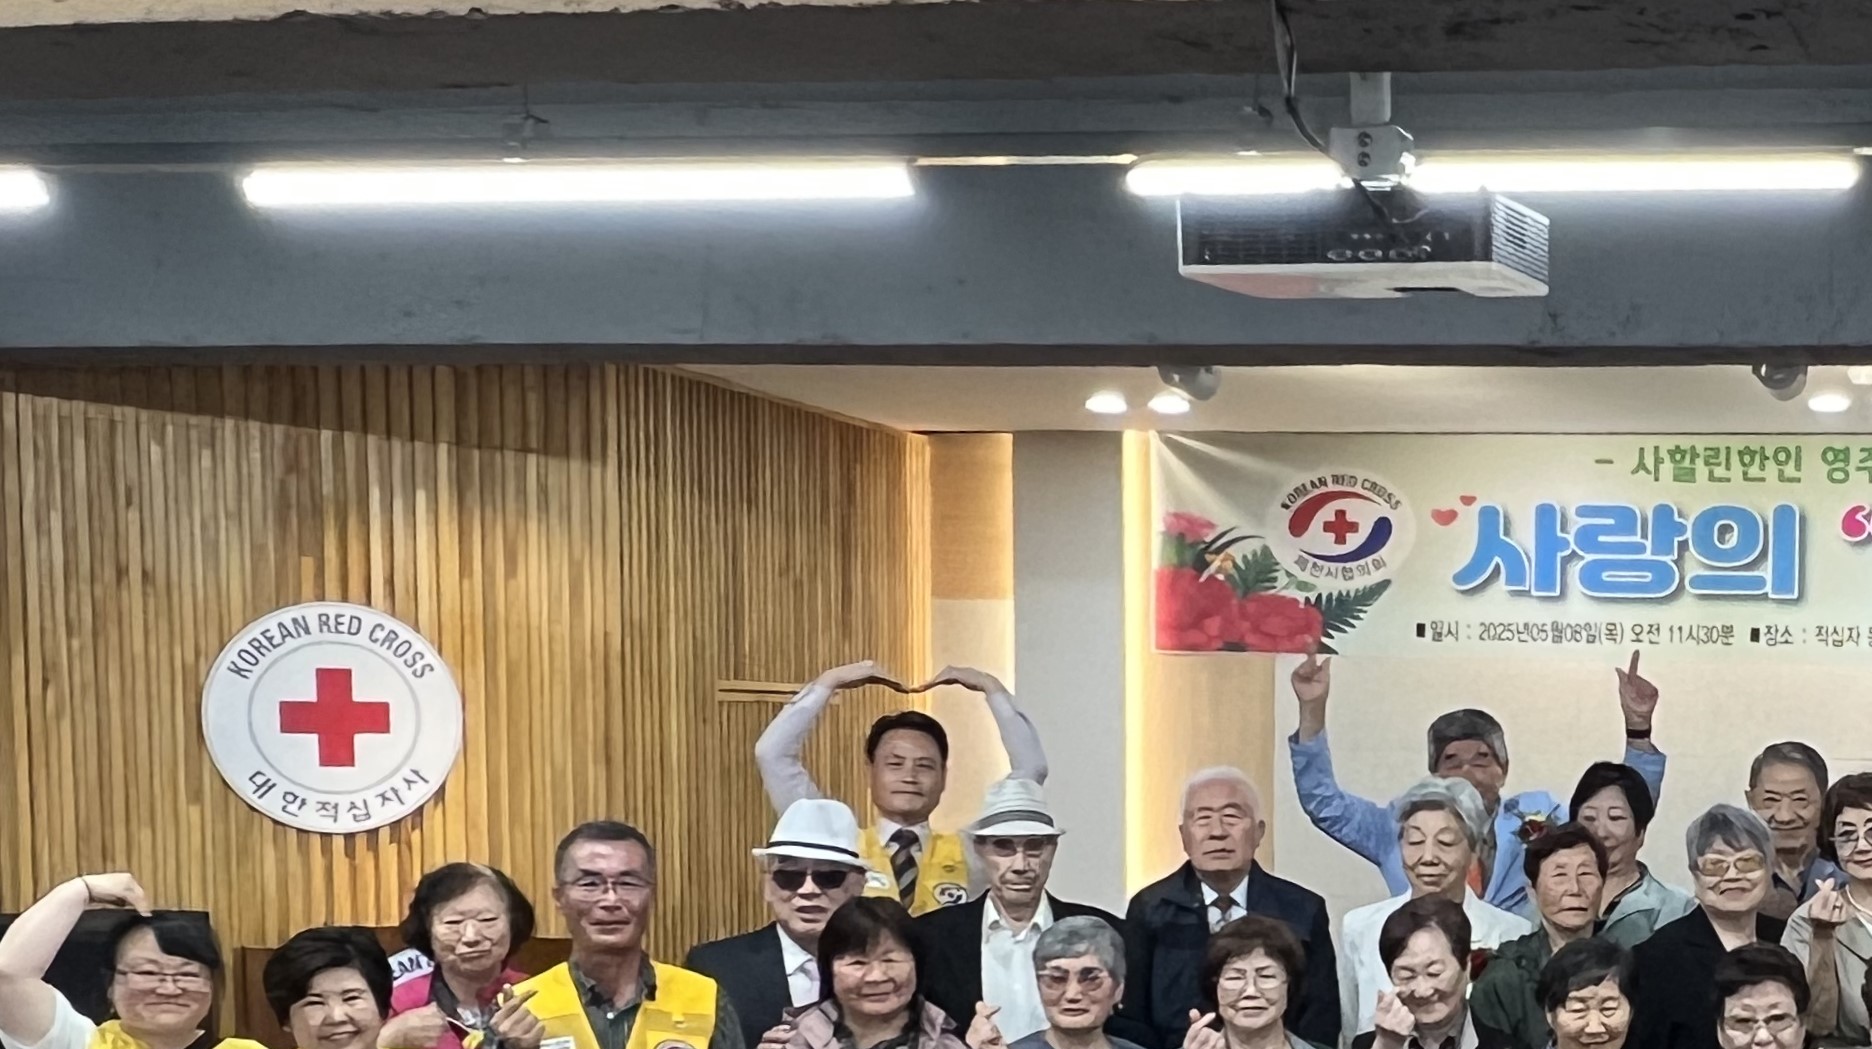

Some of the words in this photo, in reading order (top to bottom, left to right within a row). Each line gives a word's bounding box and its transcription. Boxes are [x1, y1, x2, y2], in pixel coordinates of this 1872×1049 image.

[1630, 445, 1802, 484] 사할린한인
[1451, 502, 1800, 600] 사랑의
[226, 613, 312, 680] KOREAN
[317, 612, 363, 637] RED
[368, 621, 435, 680] CROSS
[1630, 622, 1661, 645] 오전
[1668, 623, 1735, 647] 11시30분
[1814, 624, 1861, 648] 적십자
[247, 767, 431, 824] 대한적십자사
